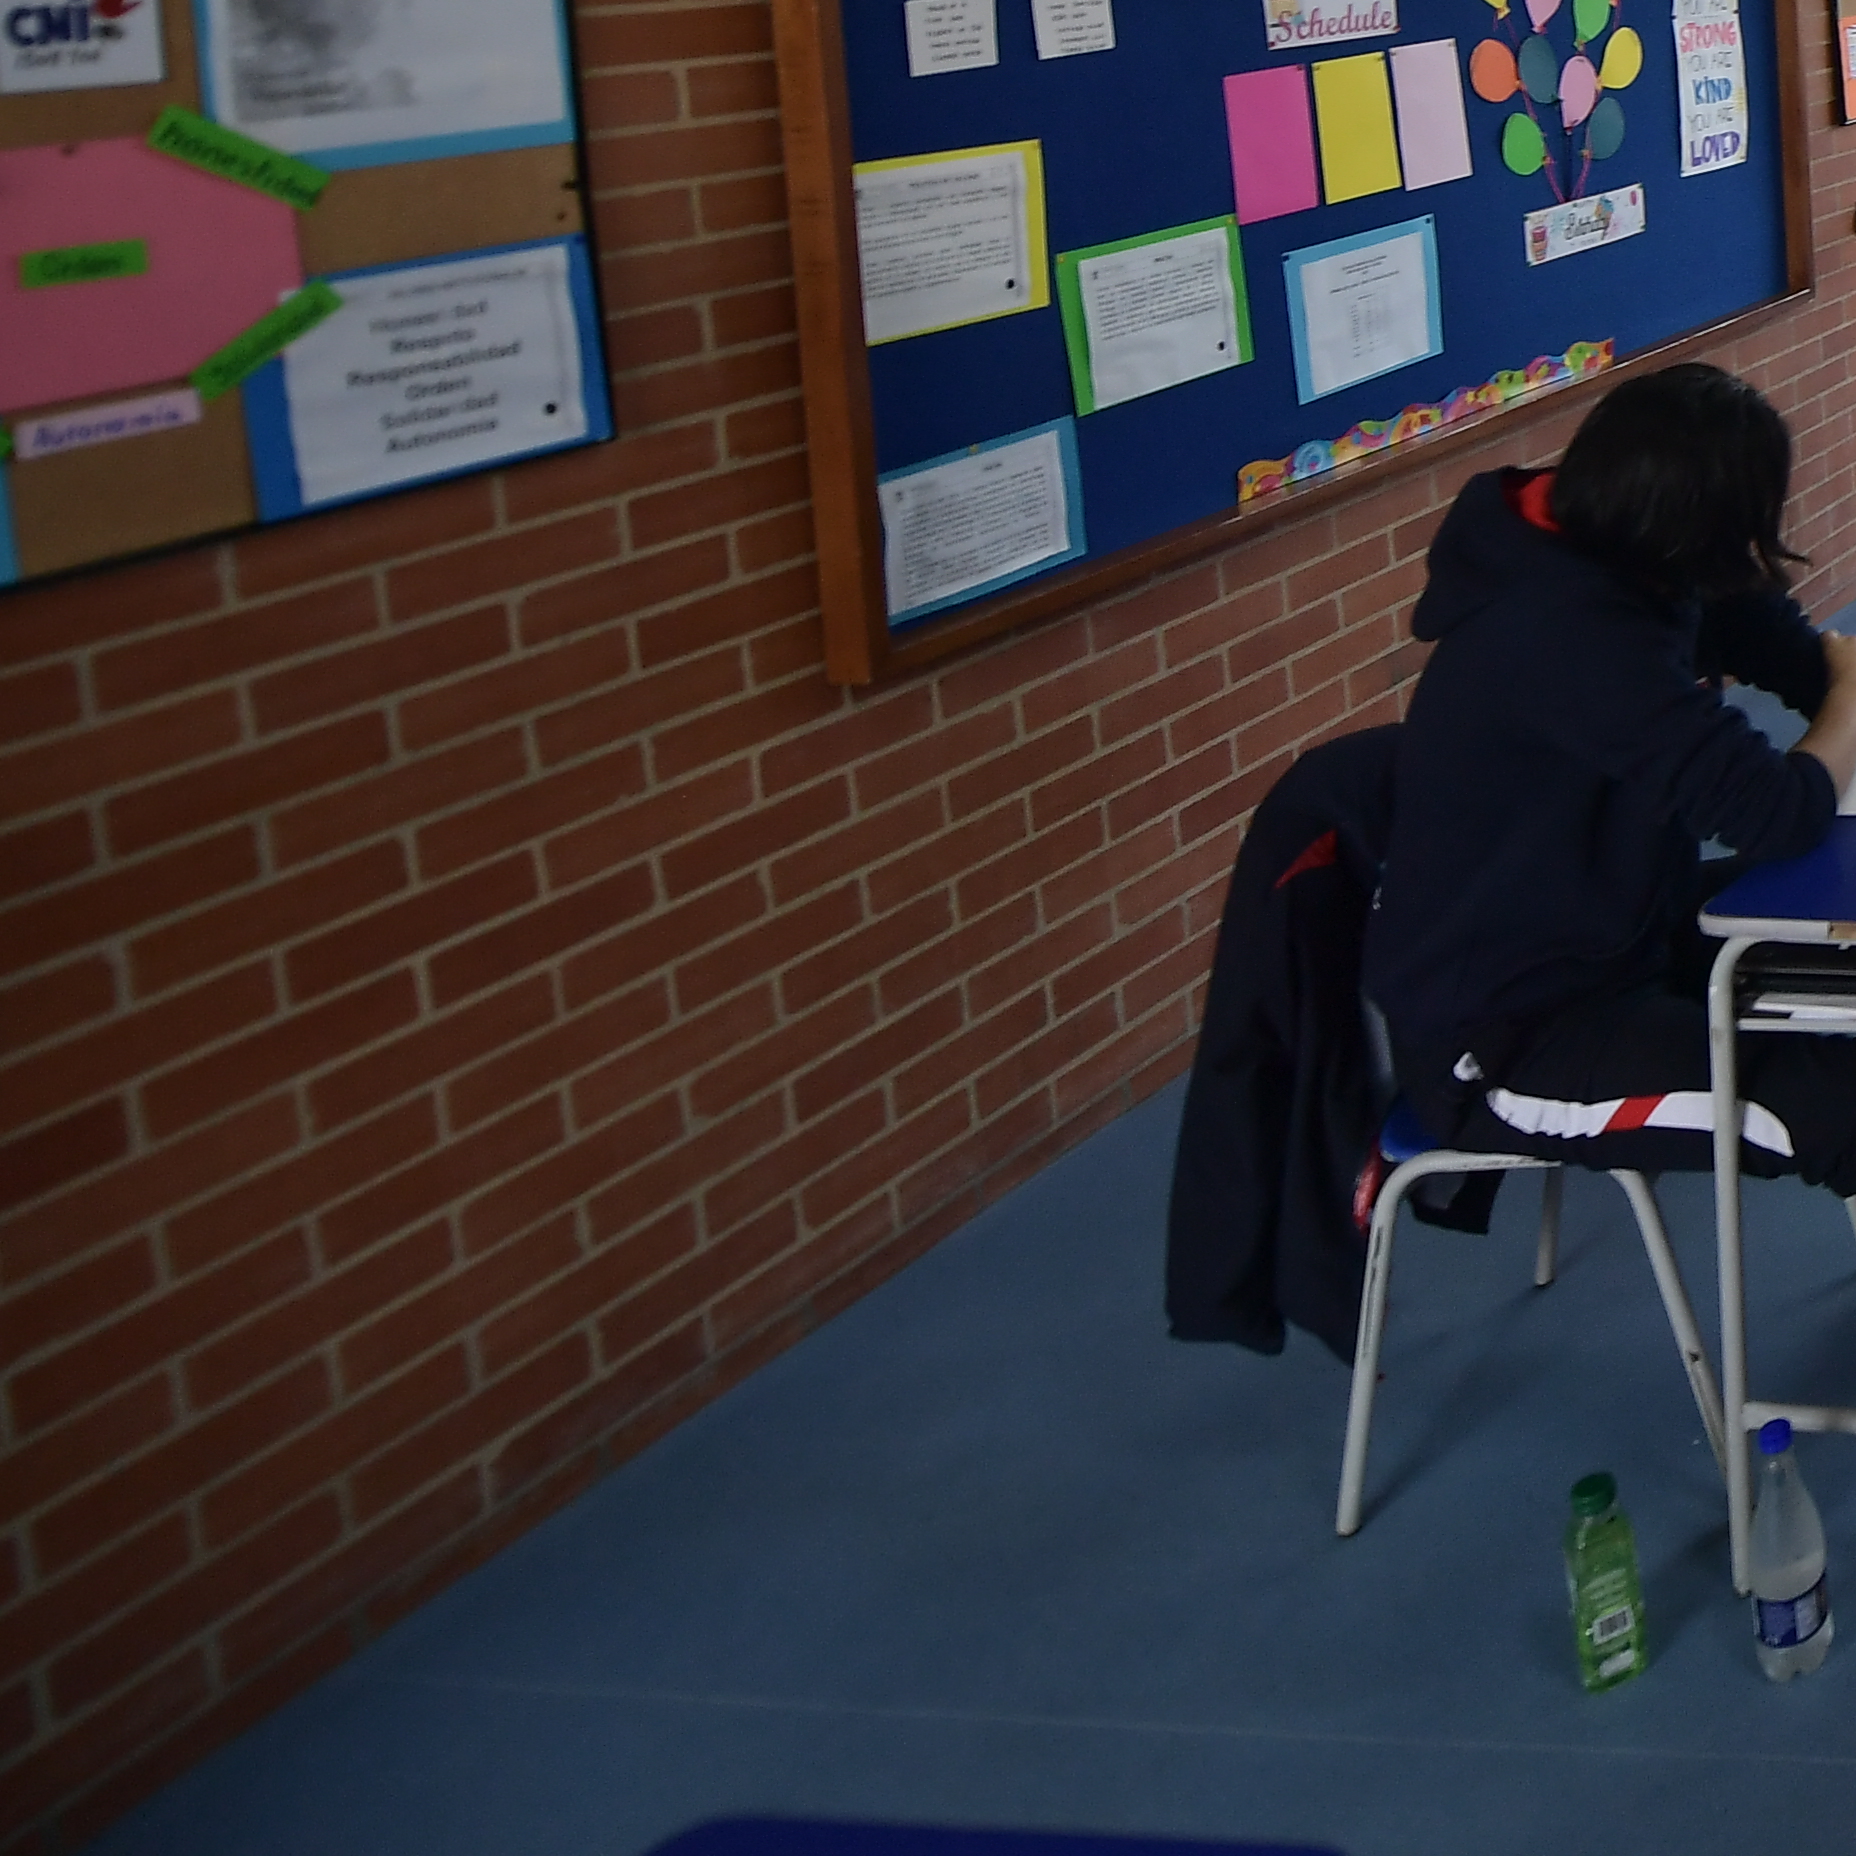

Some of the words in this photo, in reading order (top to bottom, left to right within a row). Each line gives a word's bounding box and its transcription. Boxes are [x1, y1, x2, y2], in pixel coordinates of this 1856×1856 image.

[1276, 0, 1392, 42] Schedule
[1679, 20, 1737, 54] STRONG
[1692, 75, 1733, 106] KIND
[1690, 129, 1742, 167] LOVED
